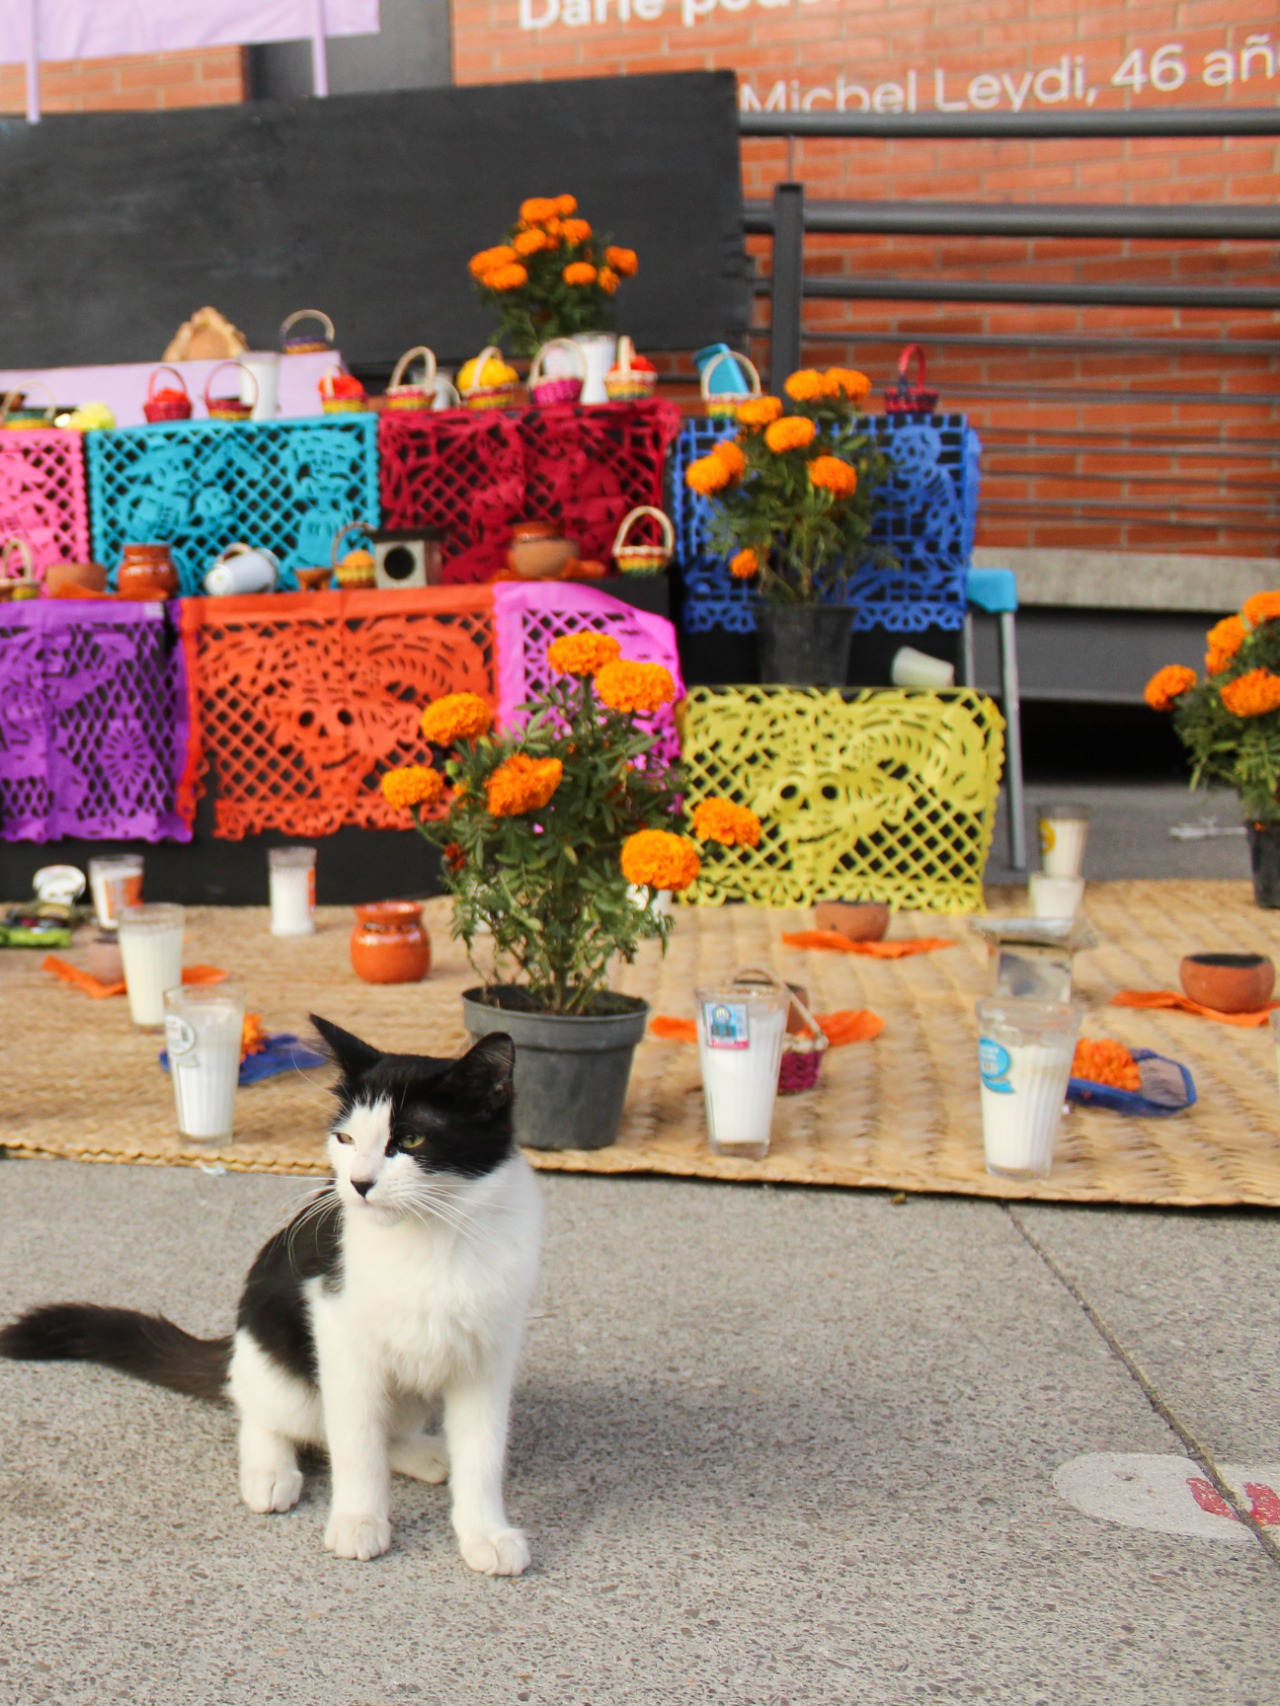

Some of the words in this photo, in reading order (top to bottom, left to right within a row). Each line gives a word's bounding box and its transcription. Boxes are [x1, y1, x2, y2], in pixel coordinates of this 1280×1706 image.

[739, 69, 917, 113] Michel
[934, 55, 1097, 112] Leydi,
[1111, 43, 1187, 93] 46
[1202, 33, 1280, 87] añ
